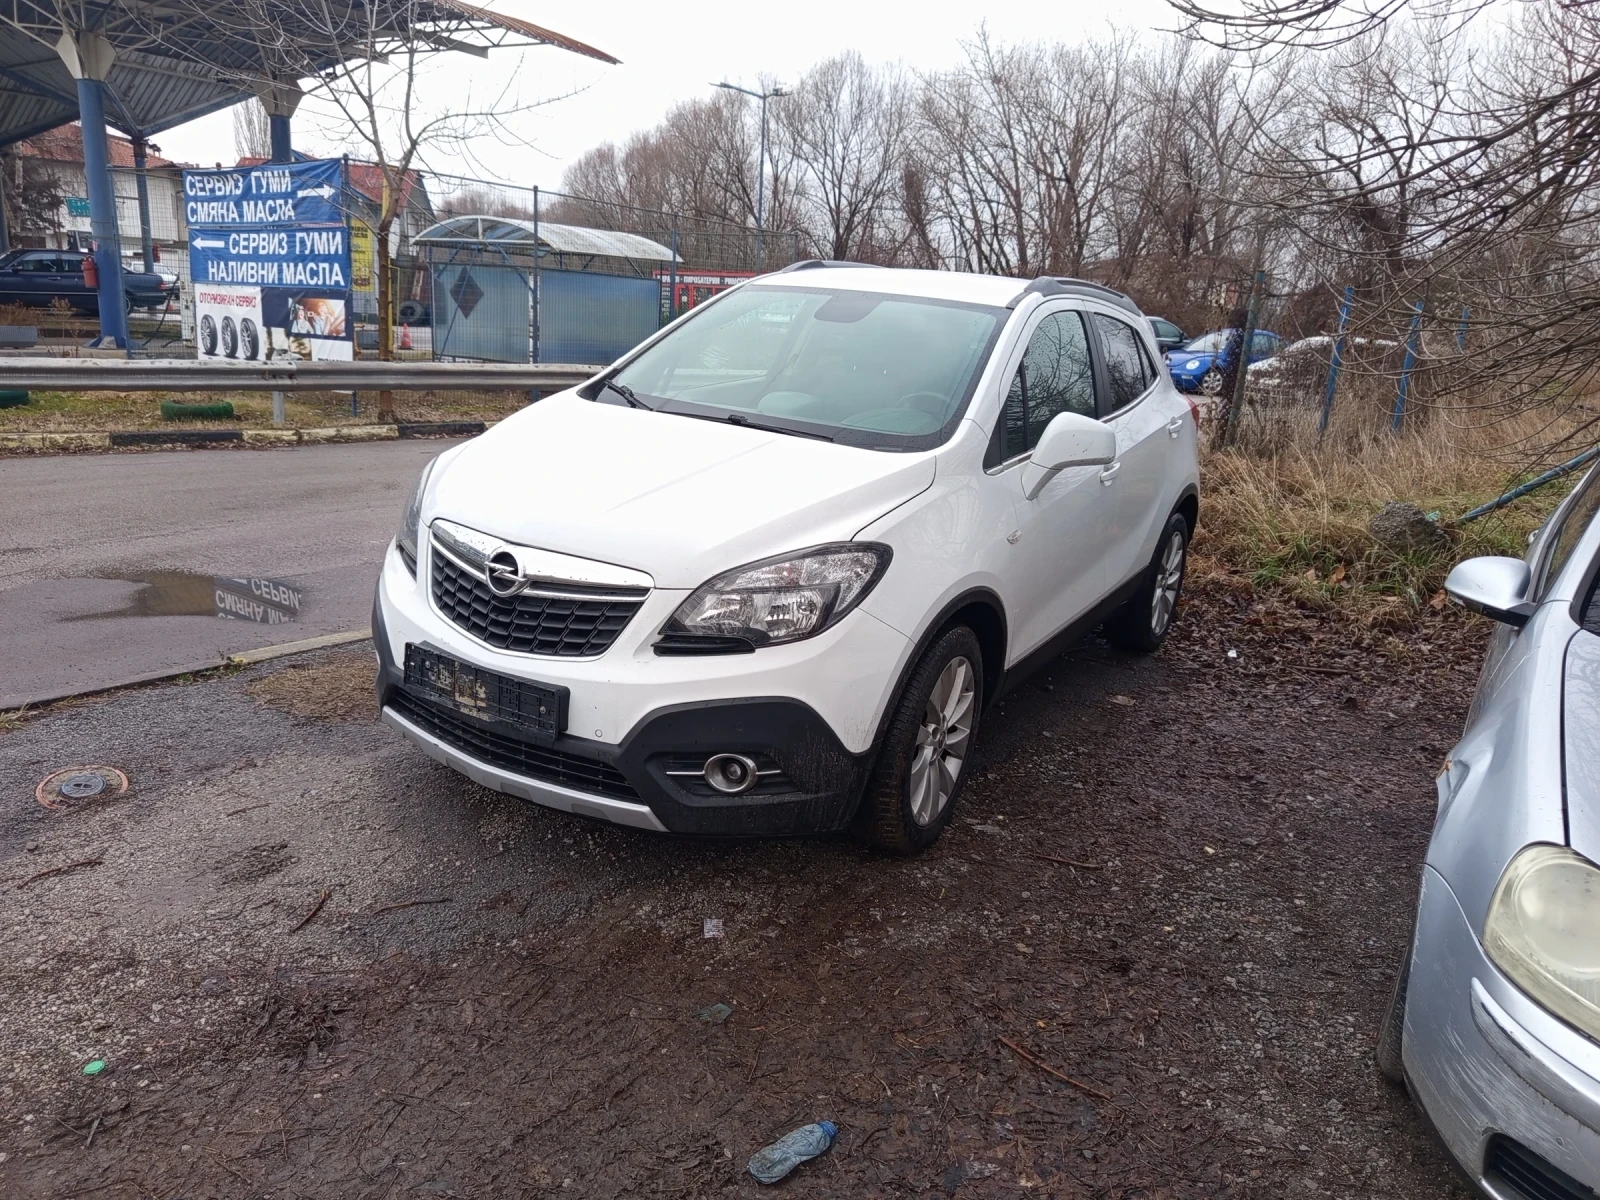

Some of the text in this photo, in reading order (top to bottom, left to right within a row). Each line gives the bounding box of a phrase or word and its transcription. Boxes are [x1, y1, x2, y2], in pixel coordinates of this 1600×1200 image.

[186, 170, 291, 196] СЕРВИЗ ГУМИ
[187, 200, 295, 223] СМЯНА МАСЛА
[229, 231, 343, 255] СЕРВИЗ ГУМИ
[208, 260, 345, 286] НАЛИВНИ МАСЛА
[199, 292, 257, 308] ОТОРИЗИРАН СЕРВИЗ
